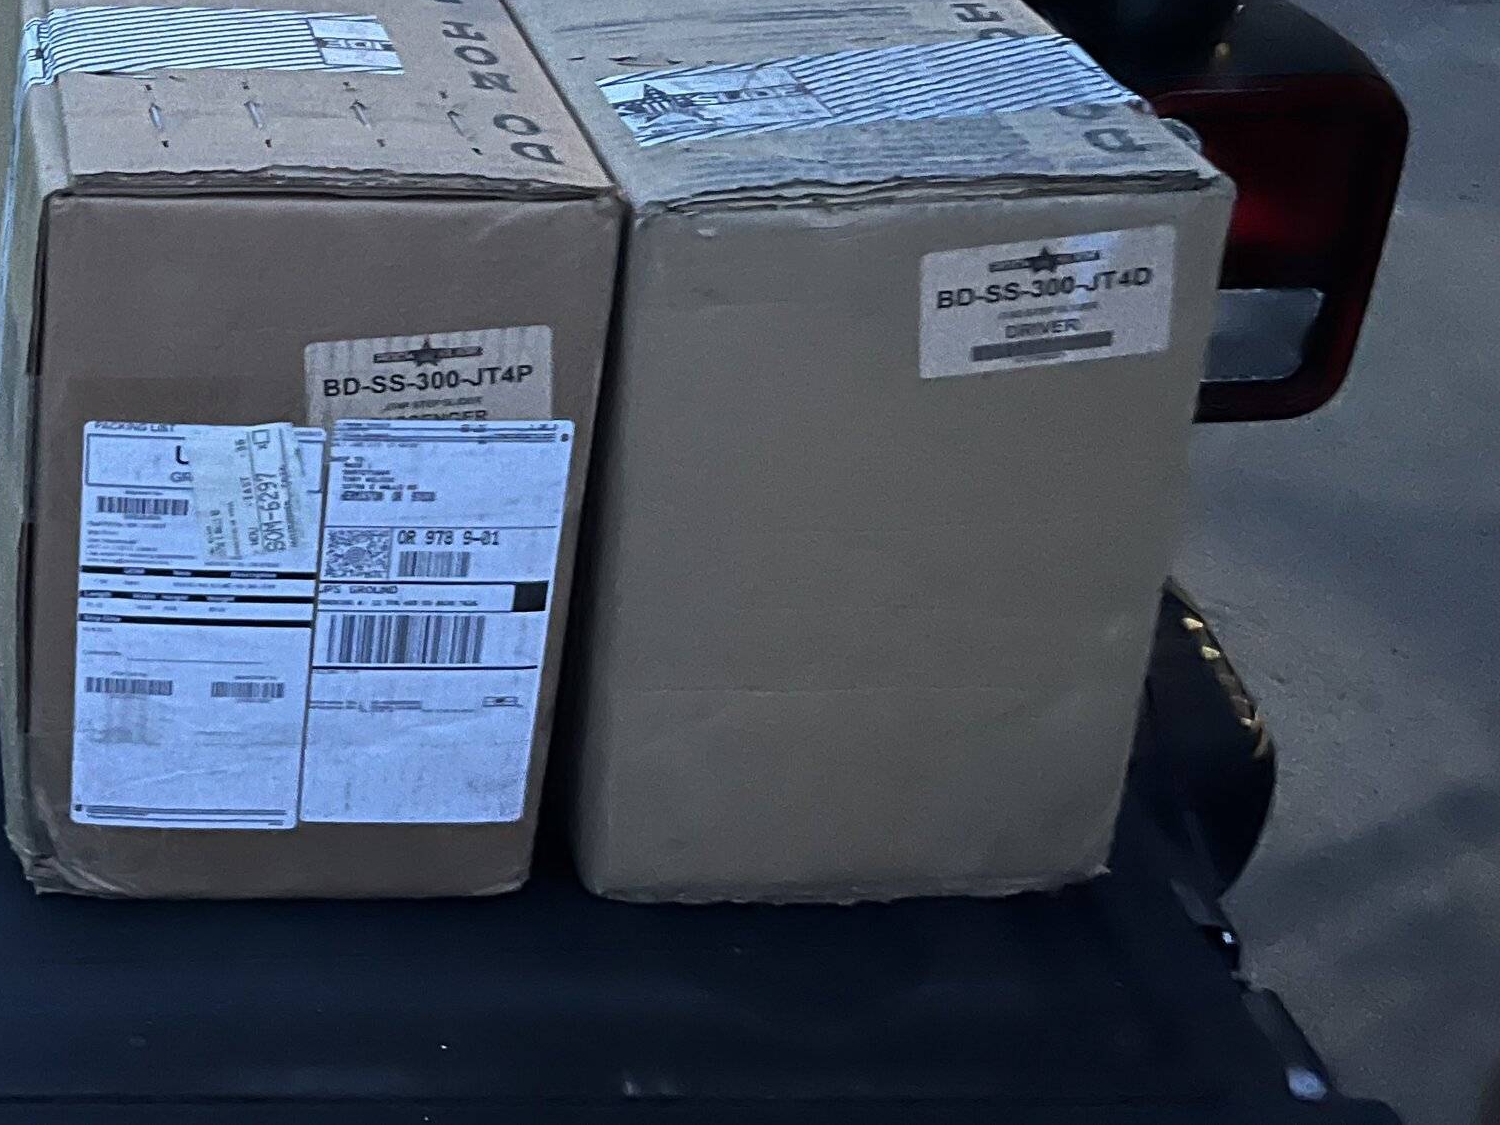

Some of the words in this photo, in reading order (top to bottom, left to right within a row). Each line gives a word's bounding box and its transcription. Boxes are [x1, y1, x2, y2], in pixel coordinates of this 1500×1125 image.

[936, 267, 1153, 309] BD-SS-300-JT4D
[1004, 318, 1082, 339] DRIVER
[323, 364, 534, 397] BD-SS-300-JT4P
